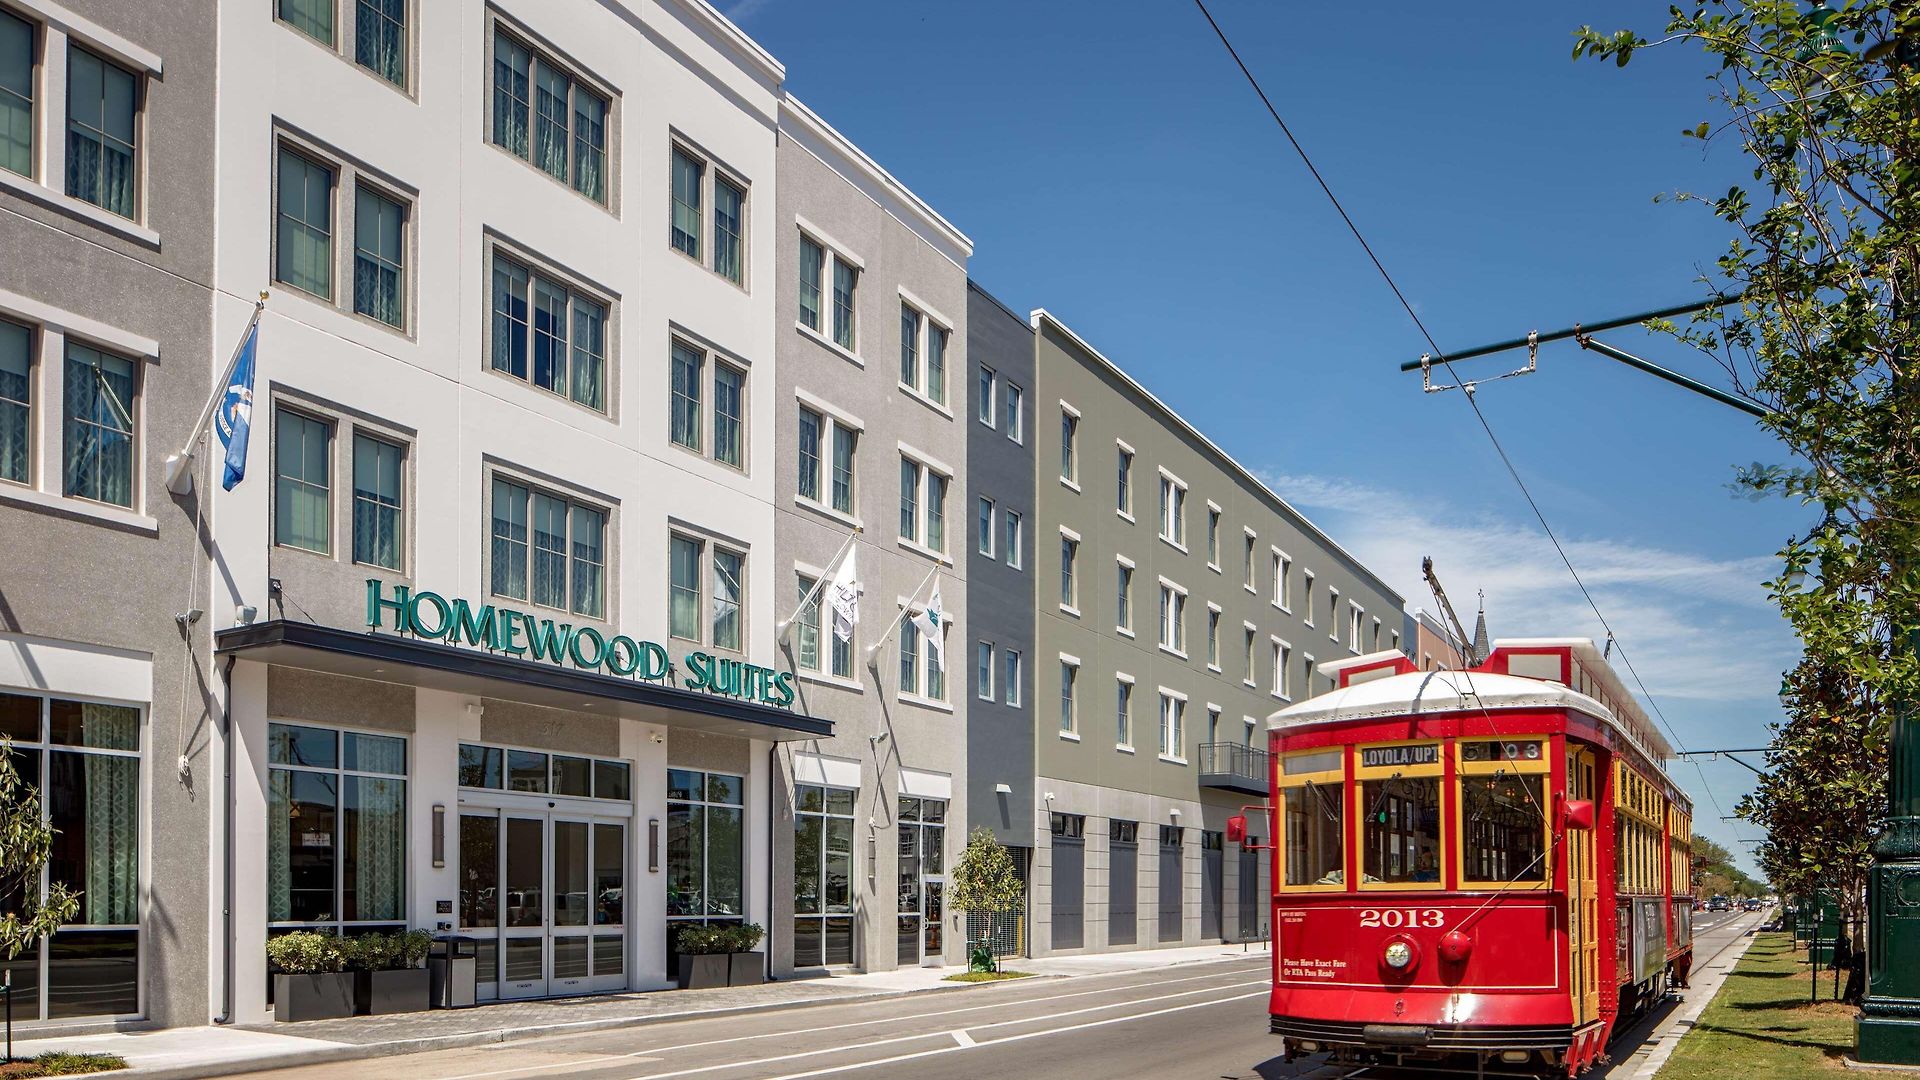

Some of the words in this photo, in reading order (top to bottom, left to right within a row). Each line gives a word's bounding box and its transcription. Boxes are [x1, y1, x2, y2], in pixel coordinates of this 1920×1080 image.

[366, 579, 669, 681] HOMEWOOD
[685, 651, 795, 706] SUITES
[1360, 909, 1445, 928] 2013
[1283, 958, 1299, 966] Please
[1300, 958, 1314, 967] Have
[1315, 959, 1332, 967] Exact
[1333, 959, 1347, 968] Fare
[1283, 968, 1291, 976] Or
[1304, 969, 1317, 977] Pass
[1318, 969, 1336, 979] Ready
